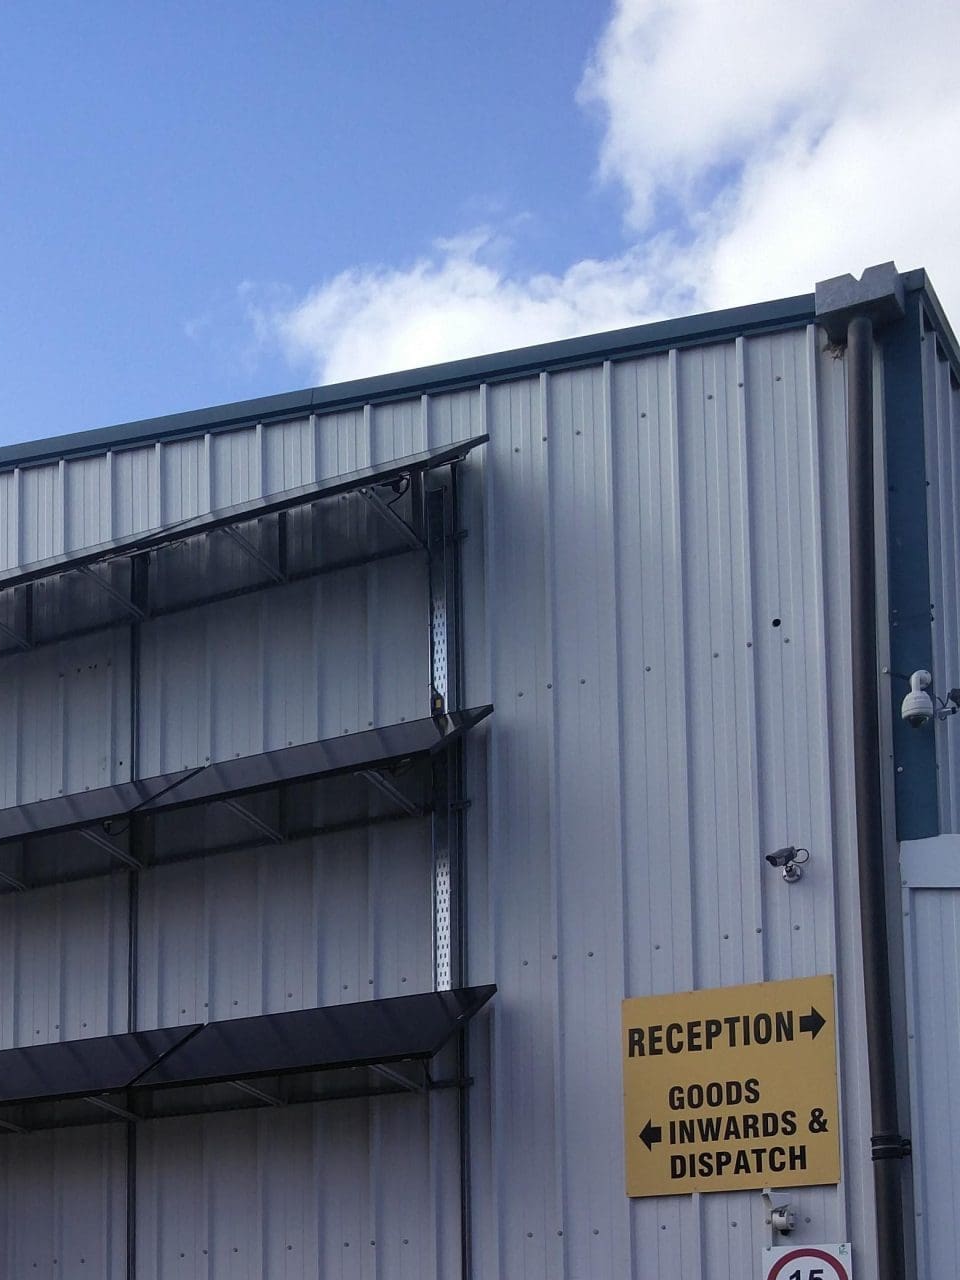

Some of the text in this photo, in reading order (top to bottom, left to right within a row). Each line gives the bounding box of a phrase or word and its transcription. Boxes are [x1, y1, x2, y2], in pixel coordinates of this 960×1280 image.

[628, 1010, 794, 1057] RECEPTION
[668, 1078, 760, 1110] GOODS
[669, 1107, 829, 1145] INWARDS &
[670, 1145, 807, 1179] DISPATCH
